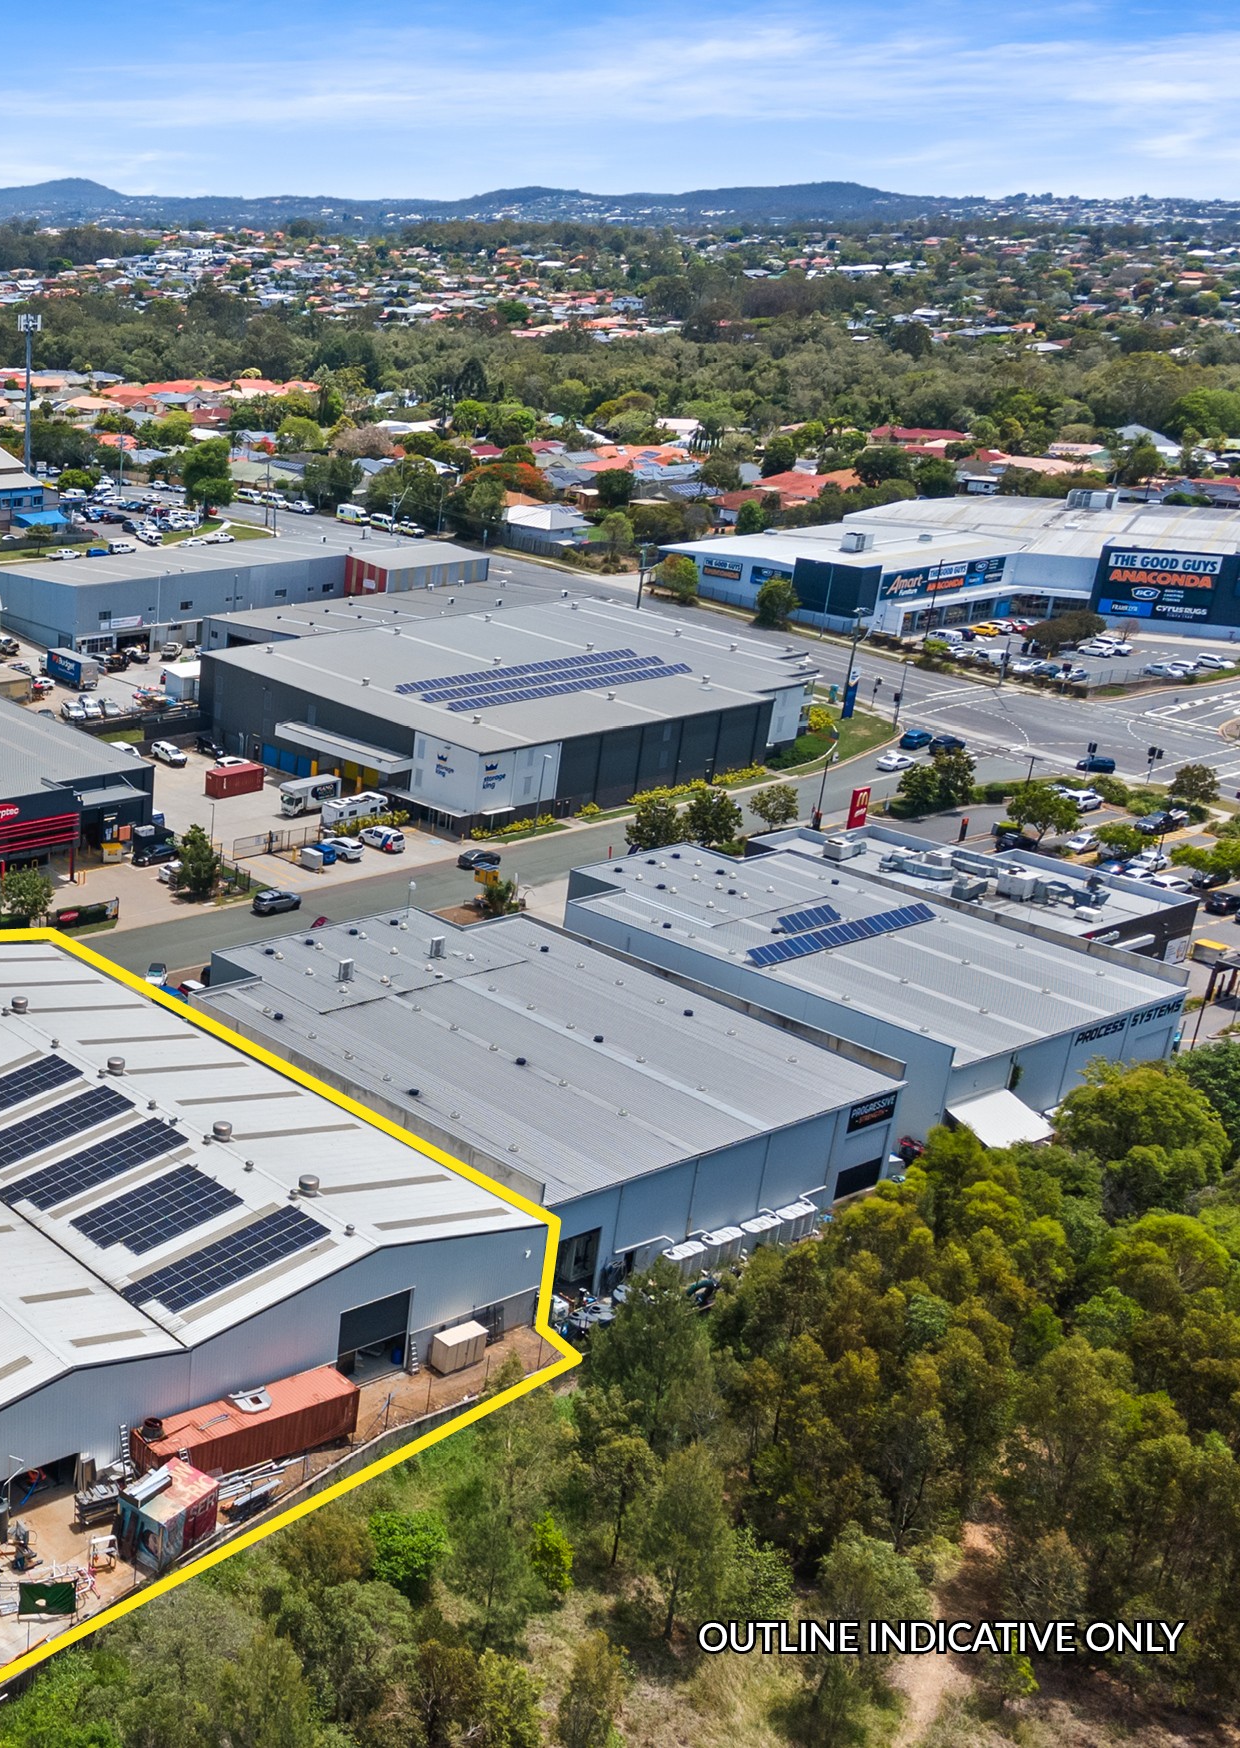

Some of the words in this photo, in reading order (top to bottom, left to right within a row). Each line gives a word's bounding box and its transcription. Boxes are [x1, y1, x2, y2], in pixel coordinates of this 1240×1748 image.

[954, 565, 968, 574] GUYS
[1114, 554, 1137, 567] THE
[1141, 556, 1179, 570] GOOD
[1182, 558, 1218, 573] GUYS
[886, 574, 924, 595] Amart
[1109, 569, 1212, 589] ANACONDA
[482, 782, 495, 790] king
[484, 773, 506, 782] storage
[1074, 1017, 1127, 1046] PROCESS
[1130, 999, 1184, 1027] SYSTEMS
[851, 1095, 896, 1118] PROGRESSIVE
